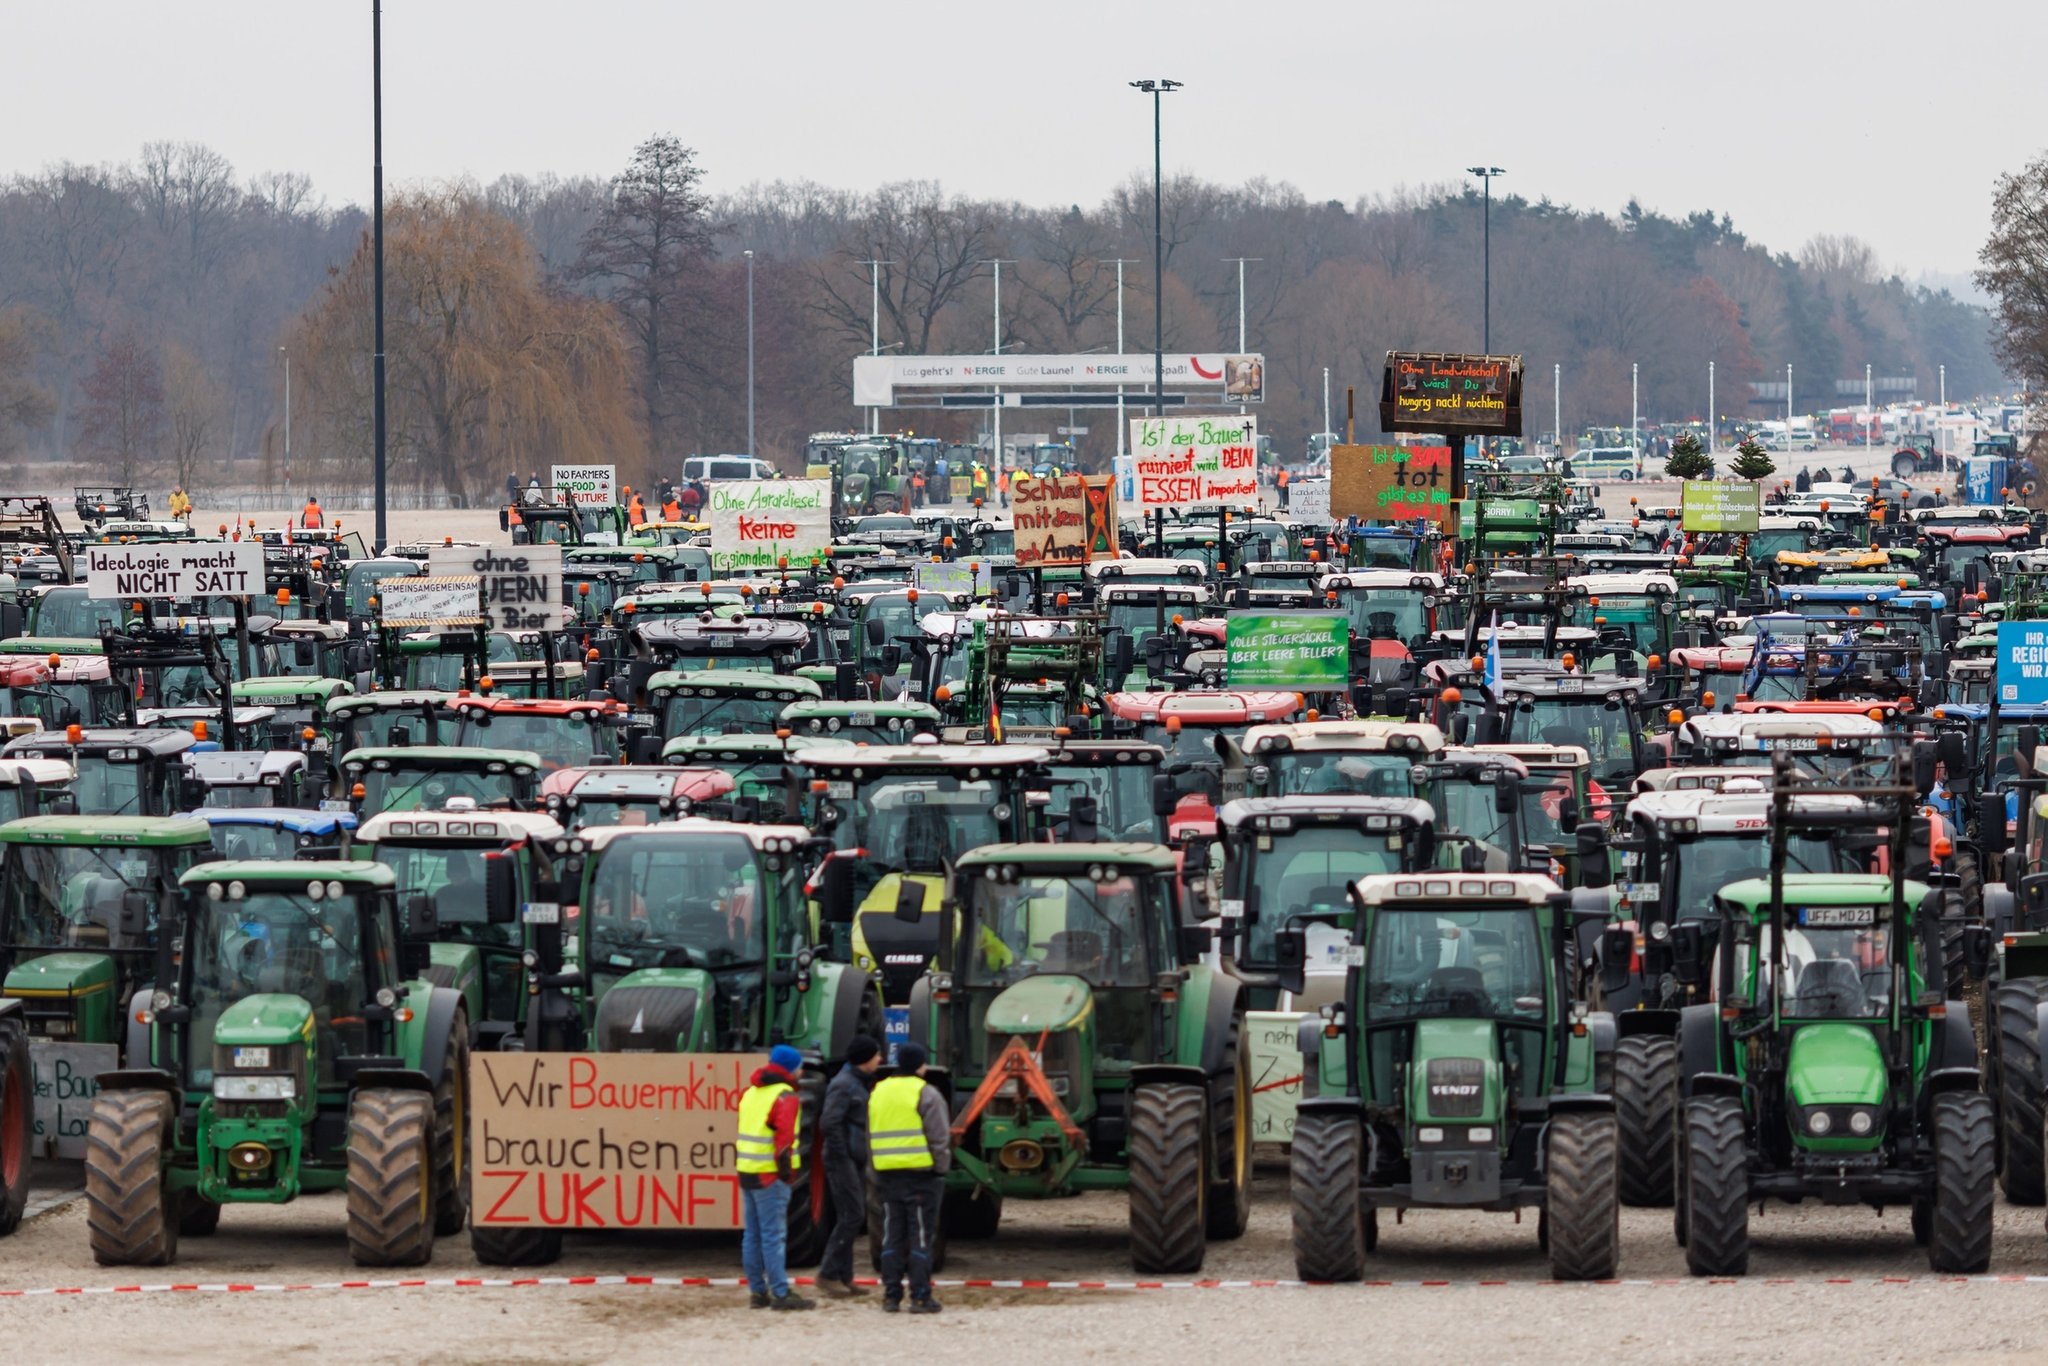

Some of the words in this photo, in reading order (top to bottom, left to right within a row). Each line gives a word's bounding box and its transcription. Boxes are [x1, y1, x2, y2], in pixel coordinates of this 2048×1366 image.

[1016, 366, 1038, 375] Gute
[1041, 366, 1074, 376] Laune!
[1140, 366, 1156, 375] Vie
[1401, 362, 1425, 374] Ohne
[1432, 362, 1500, 377] Landwirtschaft
[1465, 379, 1479, 390] Du
[1399, 395, 1431, 411] hungrig
[1436, 393, 1462, 408] nackt
[1466, 394, 1504, 409] nüchtern
[1142, 420, 1166, 446] Ist
[1171, 424, 1195, 446] der
[1198, 421, 1244, 446] Bauer
[1196, 456, 1219, 472] wird
[1222, 447, 1254, 469] DEIN
[1392, 448, 1411, 463] der
[556, 470, 569, 479] NO
[571, 470, 610, 480] FARMERS
[1394, 462, 1443, 487] tot
[572, 481, 596, 491] FOOD
[1142, 476, 1202, 503] ESSEN
[1207, 478, 1257, 499] importiert
[572, 493, 608, 503] FUTURE
[713, 490, 746, 511] Ohne
[747, 486, 821, 512] Agrardiesel
[1014, 506, 1051, 530] mit
[1052, 507, 1083, 528] dem
[91, 551, 169, 572] Ideologie
[182, 551, 236, 569] macht
[473, 549, 530, 573] ohne
[713, 547, 773, 569] regionalen
[117, 573, 181, 594] NICHT
[195, 571, 248, 592] SATT
[382, 585, 430, 593] GEMEINSAM
[430, 583, 479, 592] GEMEINSAM
[501, 606, 551, 630] Bier
[1230, 635, 1258, 647] VOLLE
[2026, 632, 2044, 645] IHR
[1231, 651, 1259, 663] ABER
[1263, 648, 1296, 660] LEERE
[1299, 646, 1345, 659] TELLER?
[2022, 665, 2043, 678] WIR
[284, 695, 296, 704] 914
[1735, 818, 1768, 828] STEY
[1807, 910, 1829, 922] UFF
[1838, 910, 1854, 921] MD
[1857, 909, 1872, 921] 21
[884, 954, 923, 963] CLAAS
[483, 1058, 562, 1108] Wir
[569, 1057, 750, 1112] Bauernkind
[1432, 1085, 1480, 1095] FENDT
[484, 1119, 679, 1170] brauchen
[482, 1171, 741, 1228] ZUKUNFT
